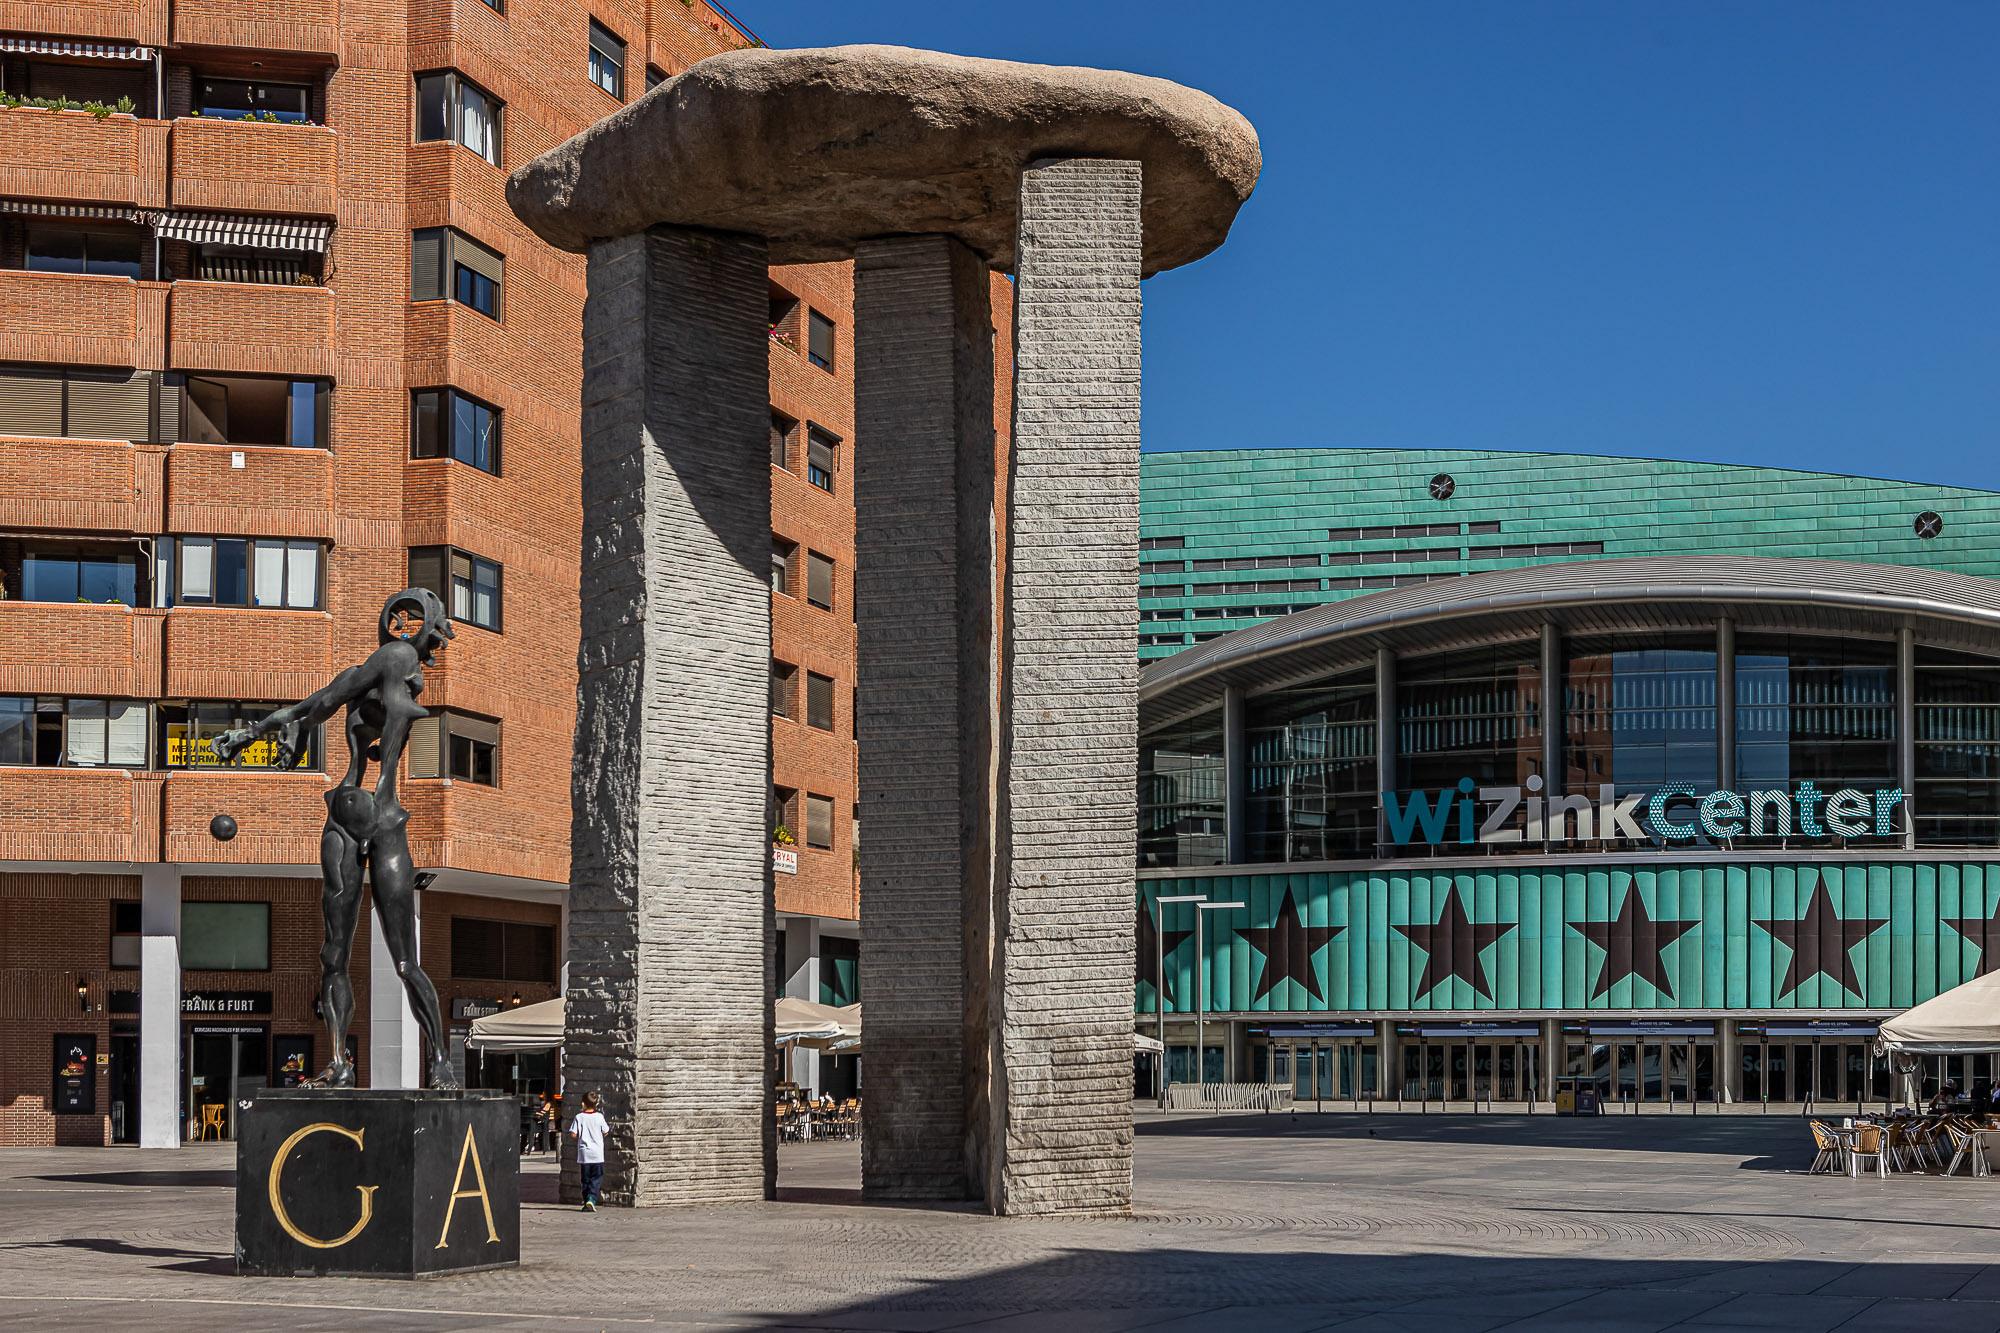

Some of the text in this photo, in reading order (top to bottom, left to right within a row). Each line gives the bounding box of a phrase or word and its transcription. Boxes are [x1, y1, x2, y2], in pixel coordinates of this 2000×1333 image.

[181, 999, 254, 1011] FRANK & FURT
[269, 1122, 380, 1249] G
[434, 1122, 501, 1249] A
